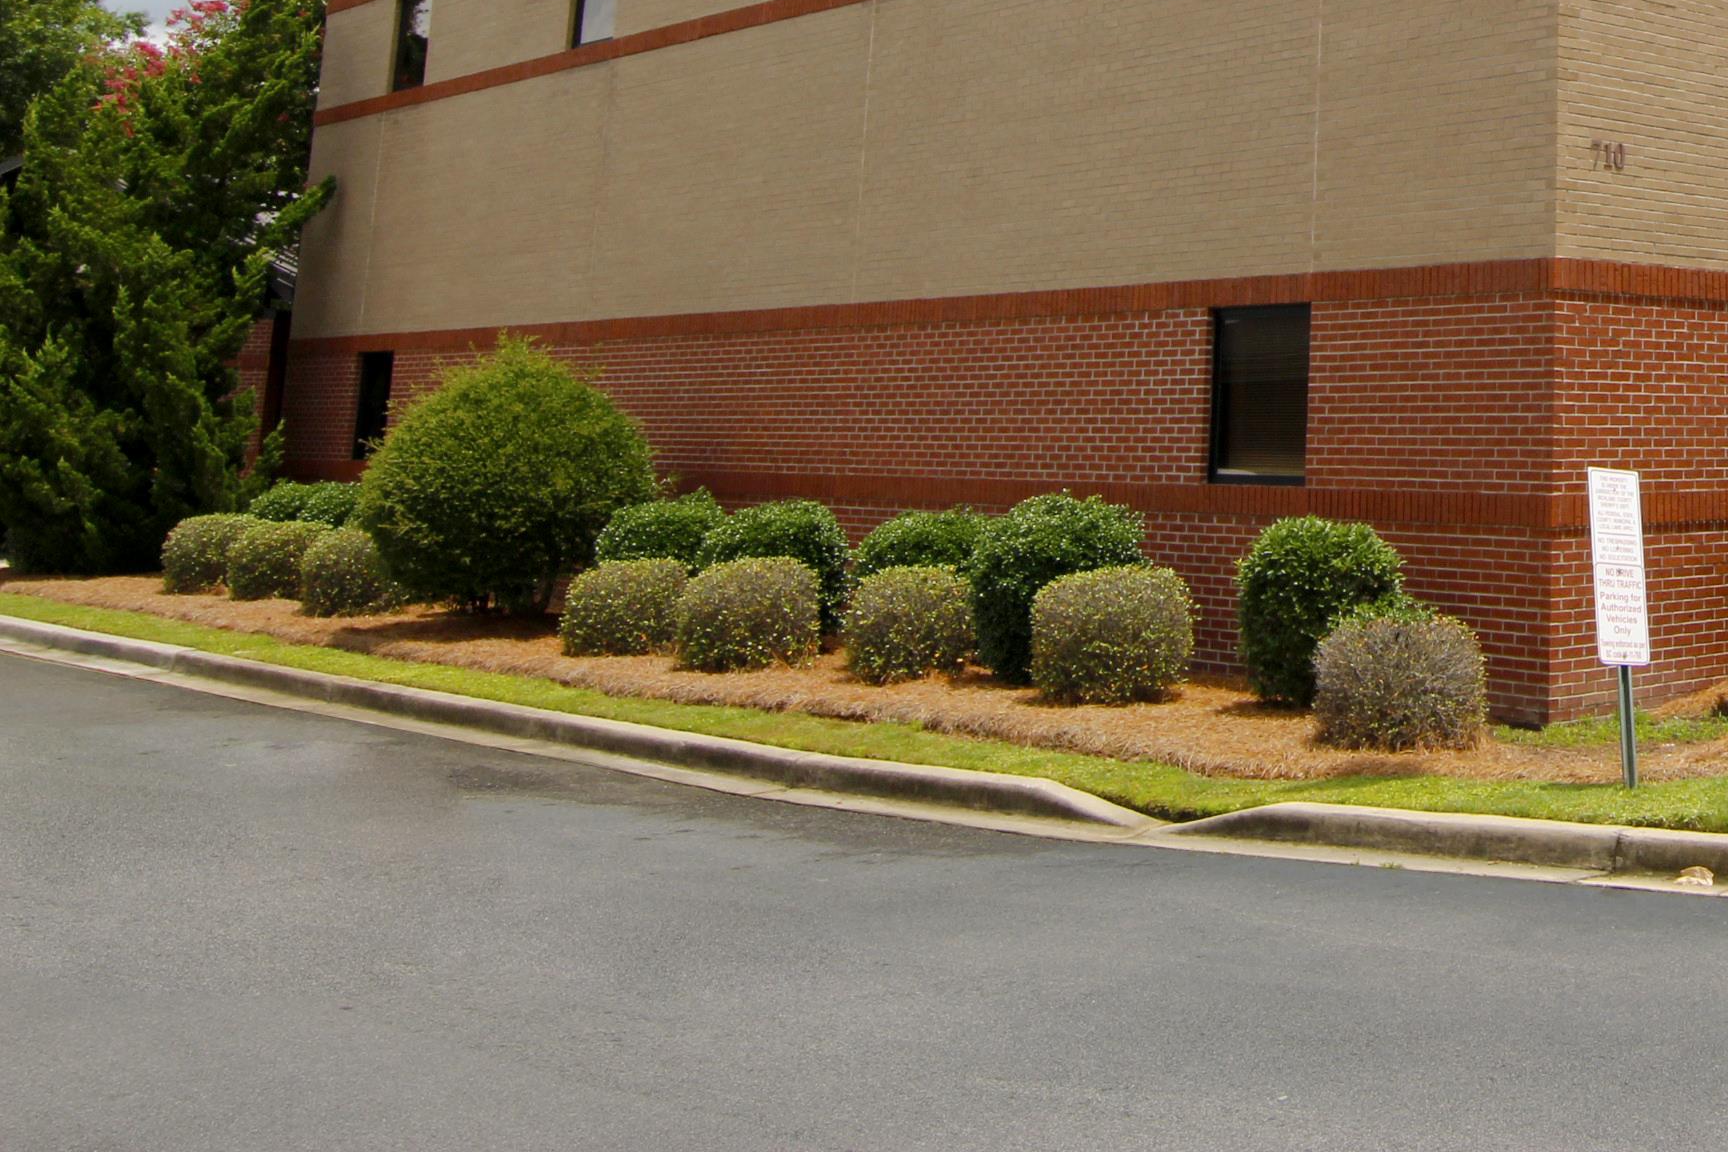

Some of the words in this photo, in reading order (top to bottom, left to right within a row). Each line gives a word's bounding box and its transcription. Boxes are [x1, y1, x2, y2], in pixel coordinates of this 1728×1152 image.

[1591, 139, 1625, 173] 710
[1600, 591, 1629, 603] Parking
[1631, 592, 1641, 602] for
[1601, 603, 1642, 614] Authorized
[1606, 614, 1638, 625] Vehicles
[1613, 625, 1632, 637] Only
